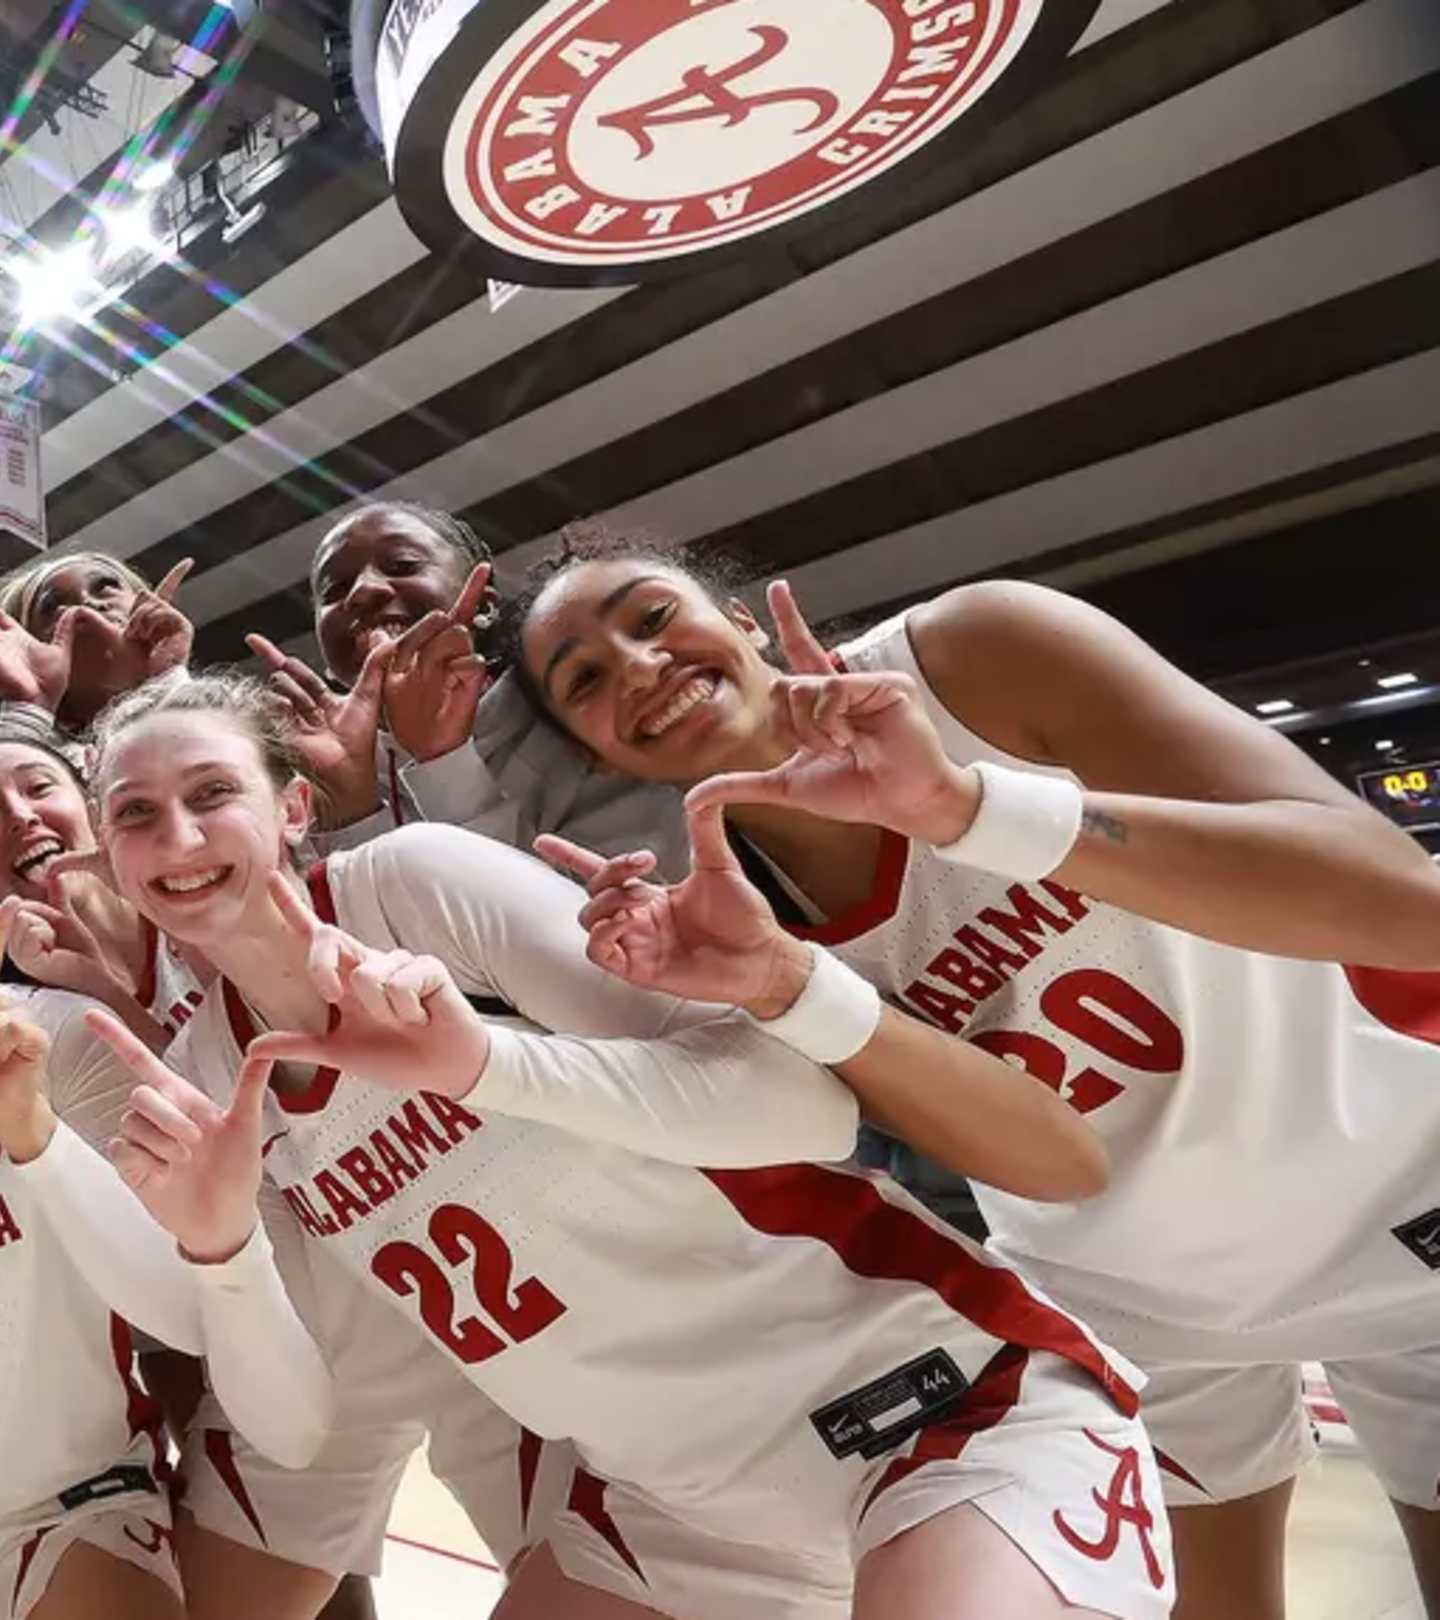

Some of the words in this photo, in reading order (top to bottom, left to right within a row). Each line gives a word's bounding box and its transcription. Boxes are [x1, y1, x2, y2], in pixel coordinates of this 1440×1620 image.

[503, 38, 753, 235] ALABAMA
[904, 879, 1092, 1035] ABAMA
[371, 1202, 567, 1365] 22
